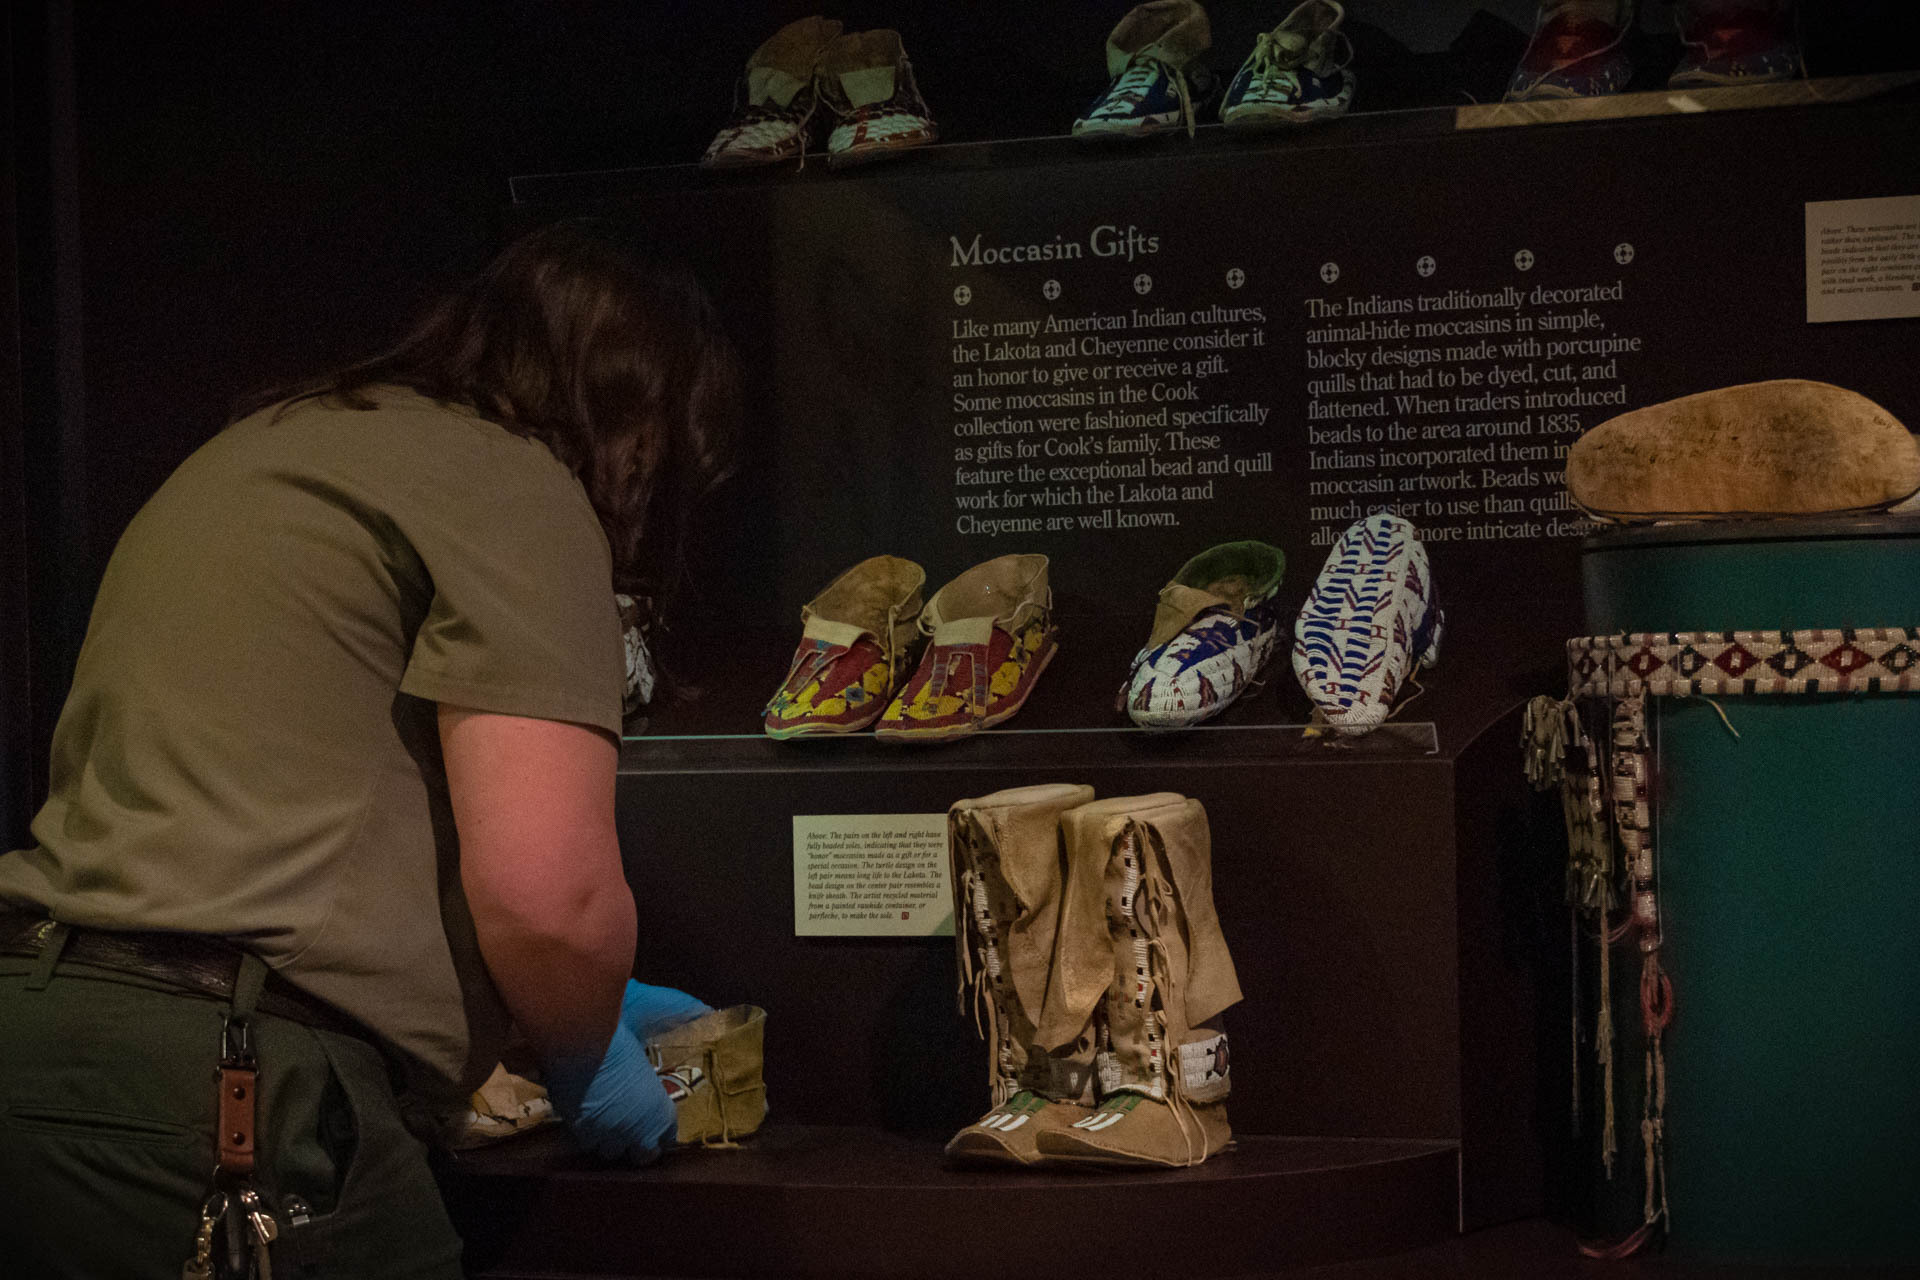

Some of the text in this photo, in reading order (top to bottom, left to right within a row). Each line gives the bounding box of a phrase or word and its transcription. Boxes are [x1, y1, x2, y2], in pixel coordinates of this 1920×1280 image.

[950, 226, 1159, 267] Moccasin Gifts
[1304, 280, 1623, 318] The Indians traditionally decorated
[952, 304, 1266, 339] Like many American Indian cultures,
[1306, 308, 1605, 344] animal-hide moccasins in simple,
[952, 327, 1265, 363] the Lakota and Cheyenne consider it
[1307, 330, 1642, 370] blocky designs made with porcupine
[953, 354, 1229, 388] an honor to give or receive a gift.
[1307, 354, 1617, 398] quills that had to be dyed, cut, and
[954, 380, 1199, 412] Some moccasins in the Cook
[1308, 384, 1626, 420] flattened. When traders introduced
[954, 402, 1270, 437] collection were fashioned specifically
[1308, 424, 1362, 445] beads
[1366, 425, 1383, 442] to
[1388, 421, 1417, 441] the
[1422, 424, 1461, 439] area
[1466, 415, 1531, 437] around
[954, 448, 973, 461] as
[977, 440, 1013, 463] gifts
[1017, 439, 1041, 458] for
[1108, 433, 1161, 456] family.
[1165, 431, 1221, 451] These
[1309, 449, 1375, 470] Indians
[1380, 442, 1495, 469] incorporated
[1500, 442, 1548, 461] them
[955, 452, 1273, 485] feature the exceptional bead and quill
[1310, 466, 1568, 495] moccasin artwork. Beads we
[955, 480, 1214, 509] work for which the Lakota and
[1310, 500, 1361, 521] much
[1425, 500, 1443, 516] to
[1447, 501, 1479, 515] use
[1484, 494, 1525, 514] than
[956, 509, 1180, 537] Cheyenne are well known.
[1416, 528, 1463, 542] more
[1467, 516, 1541, 540] intricate
